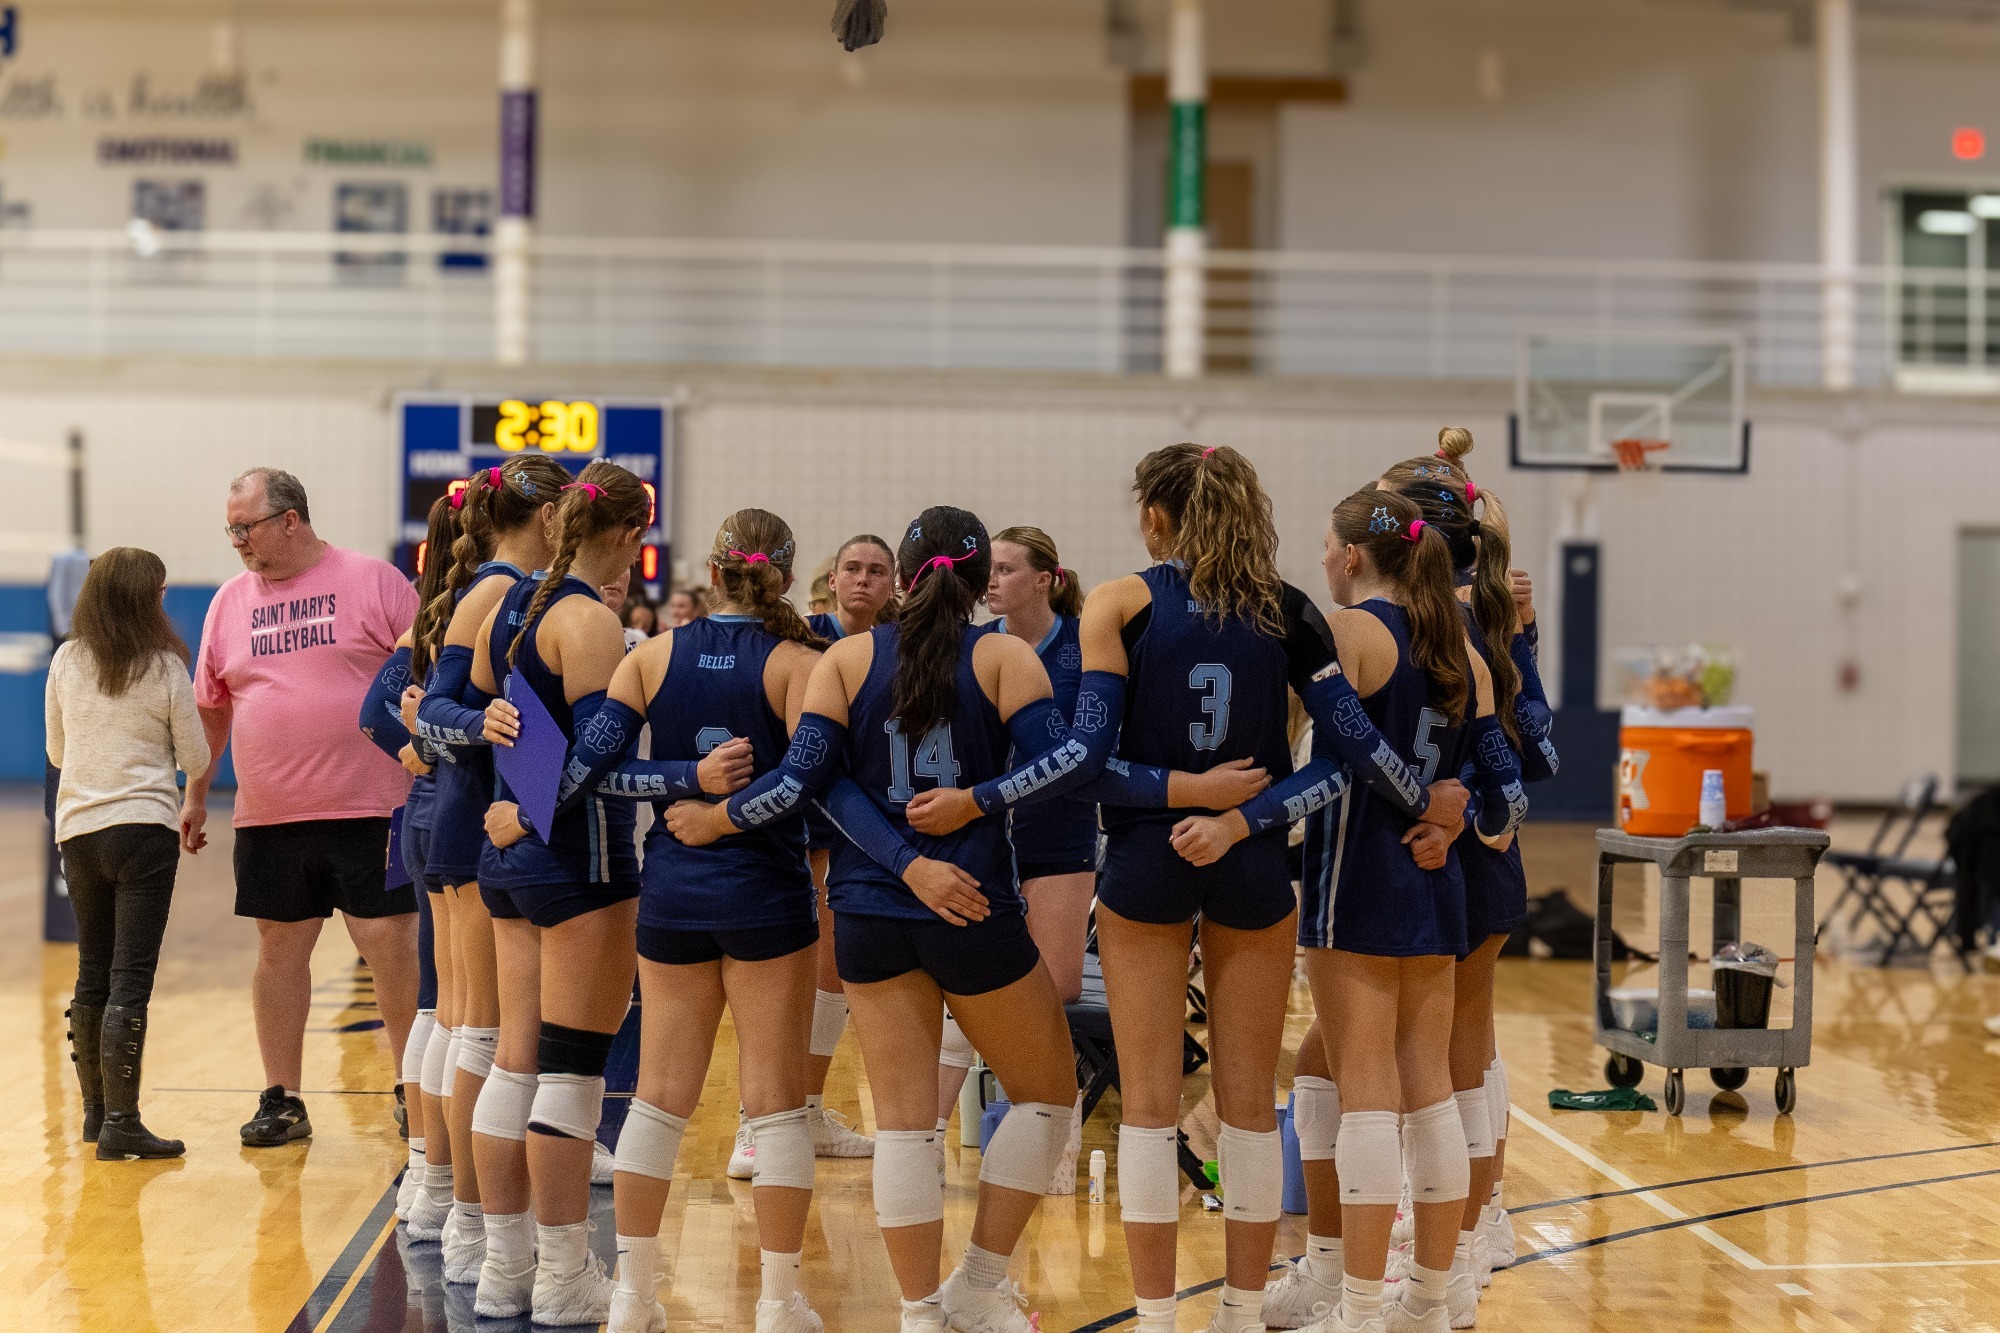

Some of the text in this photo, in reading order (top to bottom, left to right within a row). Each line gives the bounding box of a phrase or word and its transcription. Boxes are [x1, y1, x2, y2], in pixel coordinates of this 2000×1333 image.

[495, 399, 599, 452] 2:30
[252, 602, 285, 629] SAINT
[290, 593, 336, 621] MARY'S
[251, 624, 336, 657] VOLLEYBALL
[698, 654, 735, 669] BELLES
[416, 715, 470, 745] ELLES
[1189, 664, 1232, 750] 3
[885, 717, 961, 803] 14
[998, 738, 1088, 804] BELLES
[1371, 739, 1421, 806] BELLES
[1410, 707, 1448, 786] 5
[597, 771, 668, 797] ELLES
[1283, 771, 1351, 823] BELL
